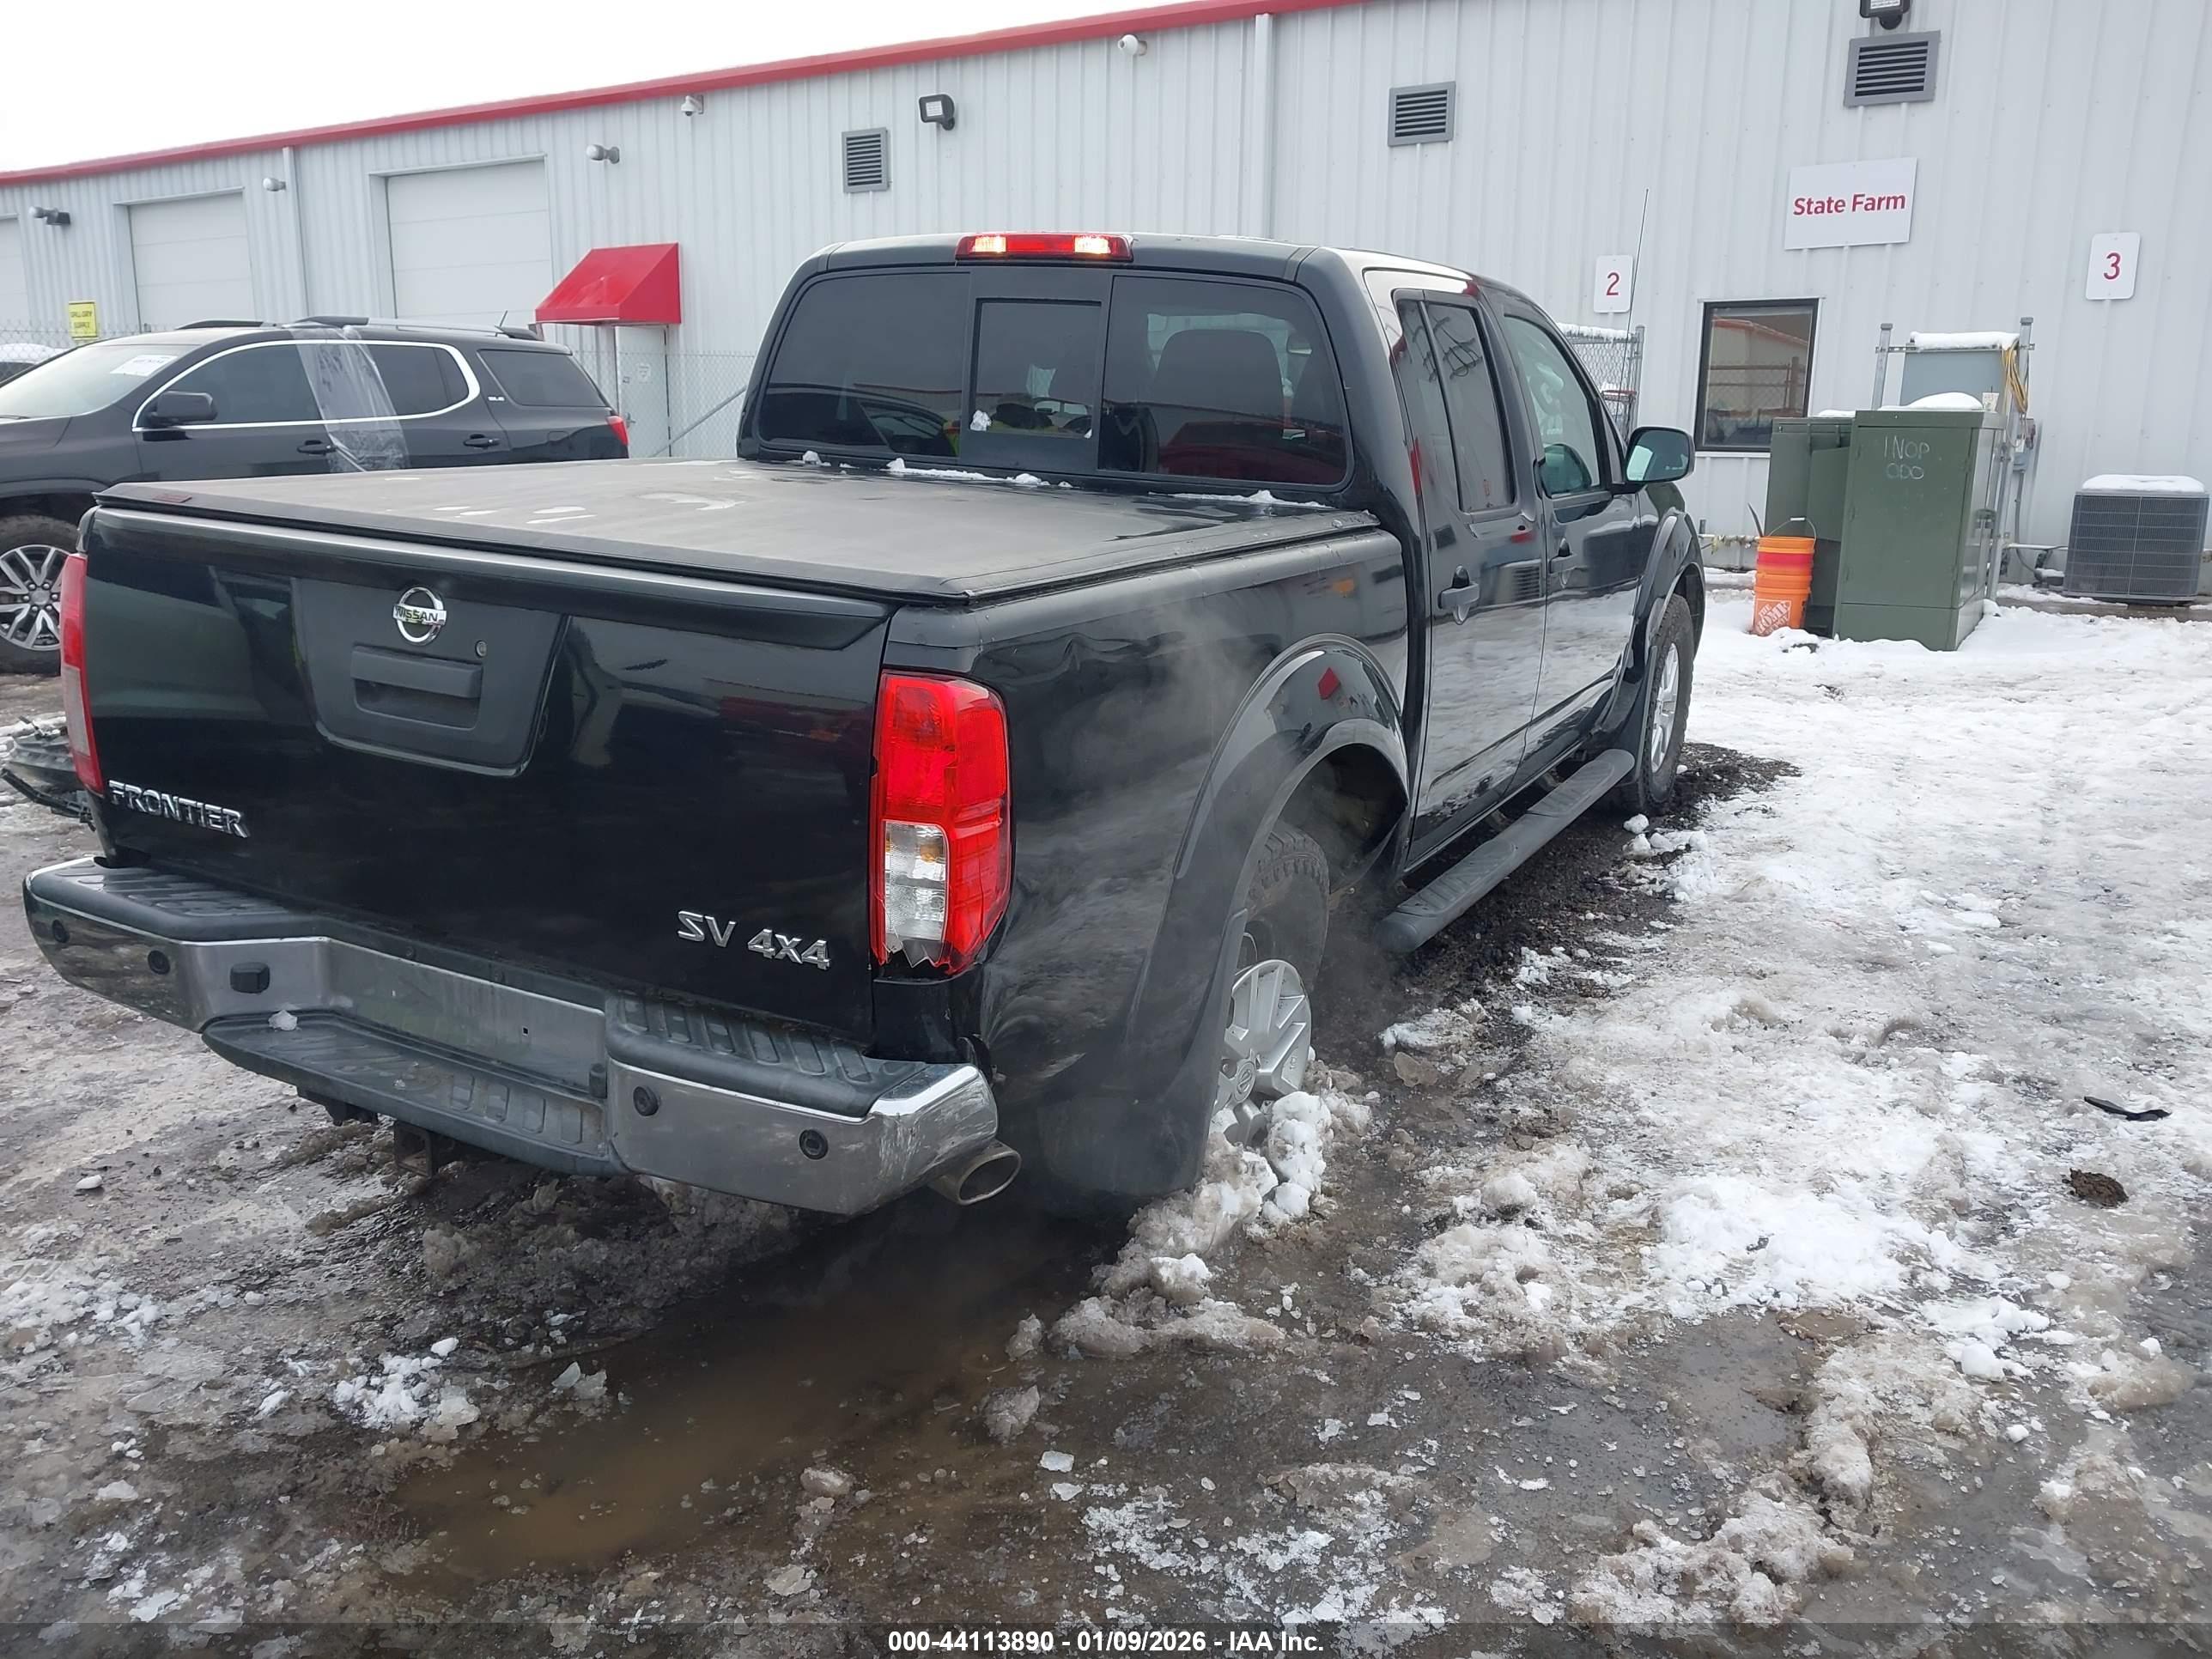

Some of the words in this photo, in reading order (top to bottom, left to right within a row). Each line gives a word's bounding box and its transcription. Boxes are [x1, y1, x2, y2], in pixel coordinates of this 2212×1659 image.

[1792, 195, 1846, 216] State
[1851, 192, 1906, 213] Farm
[2103, 252, 2121, 280] 3
[1606, 271, 1620, 296] 2
[1883, 434, 1930, 460] INOP
[395, 605, 439, 623] NISSAN
[1758, 603, 1772, 618] THE
[108, 779, 251, 839] FRONTIER
[677, 909, 738, 948] SV
